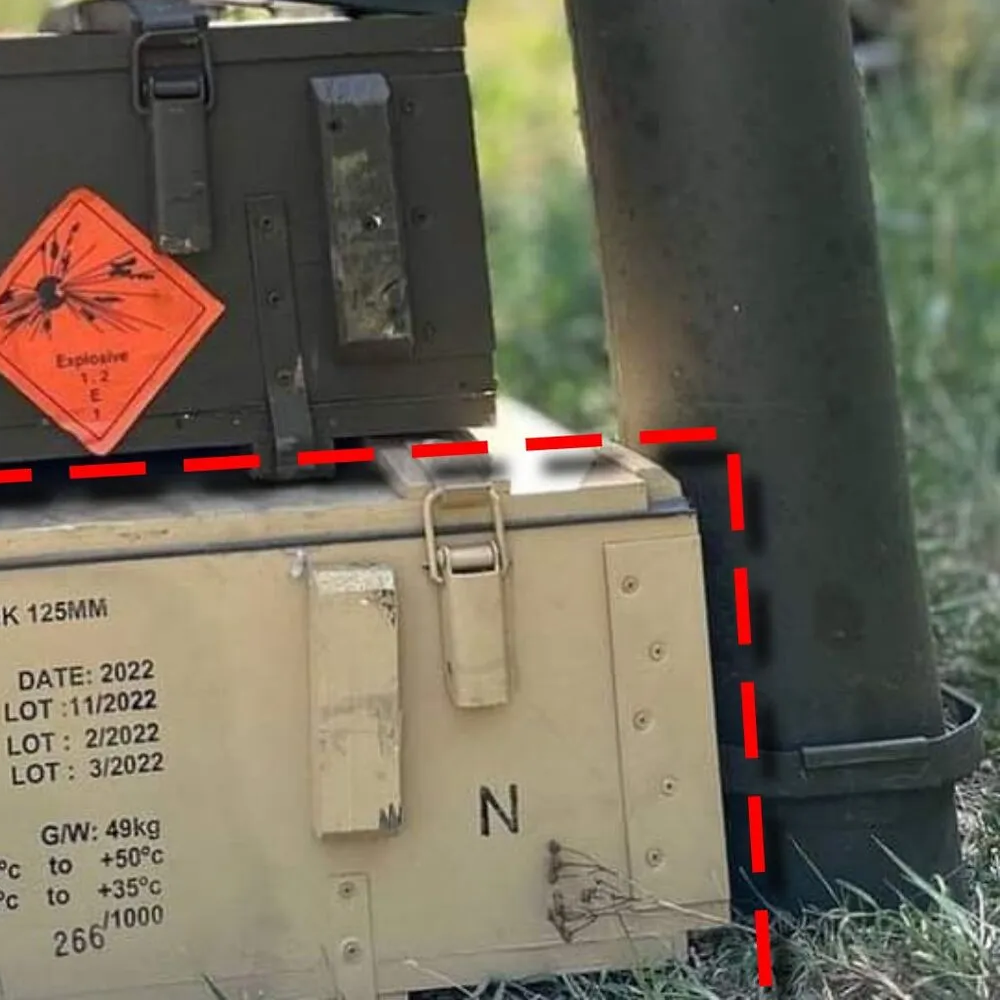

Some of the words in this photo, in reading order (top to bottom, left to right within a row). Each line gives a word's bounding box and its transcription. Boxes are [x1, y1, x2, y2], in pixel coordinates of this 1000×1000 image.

[56, 350, 129, 369] Explosive
[90, 388, 100, 402] E
[93, 409, 100, 419] 1
[27, 598, 108, 623] 125MM
[18, 666, 93, 690] DATE:
[100, 659, 154, 683] 2022
[85, 723, 159, 749] 2/2022
[89, 752, 164, 778] 3/2022
[480, 784, 518, 837] N
[41, 822, 98, 845] G/W:
[105, 818, 161, 840] 49kg
[48, 856, 73, 876] to
[46, 887, 70, 906] to
